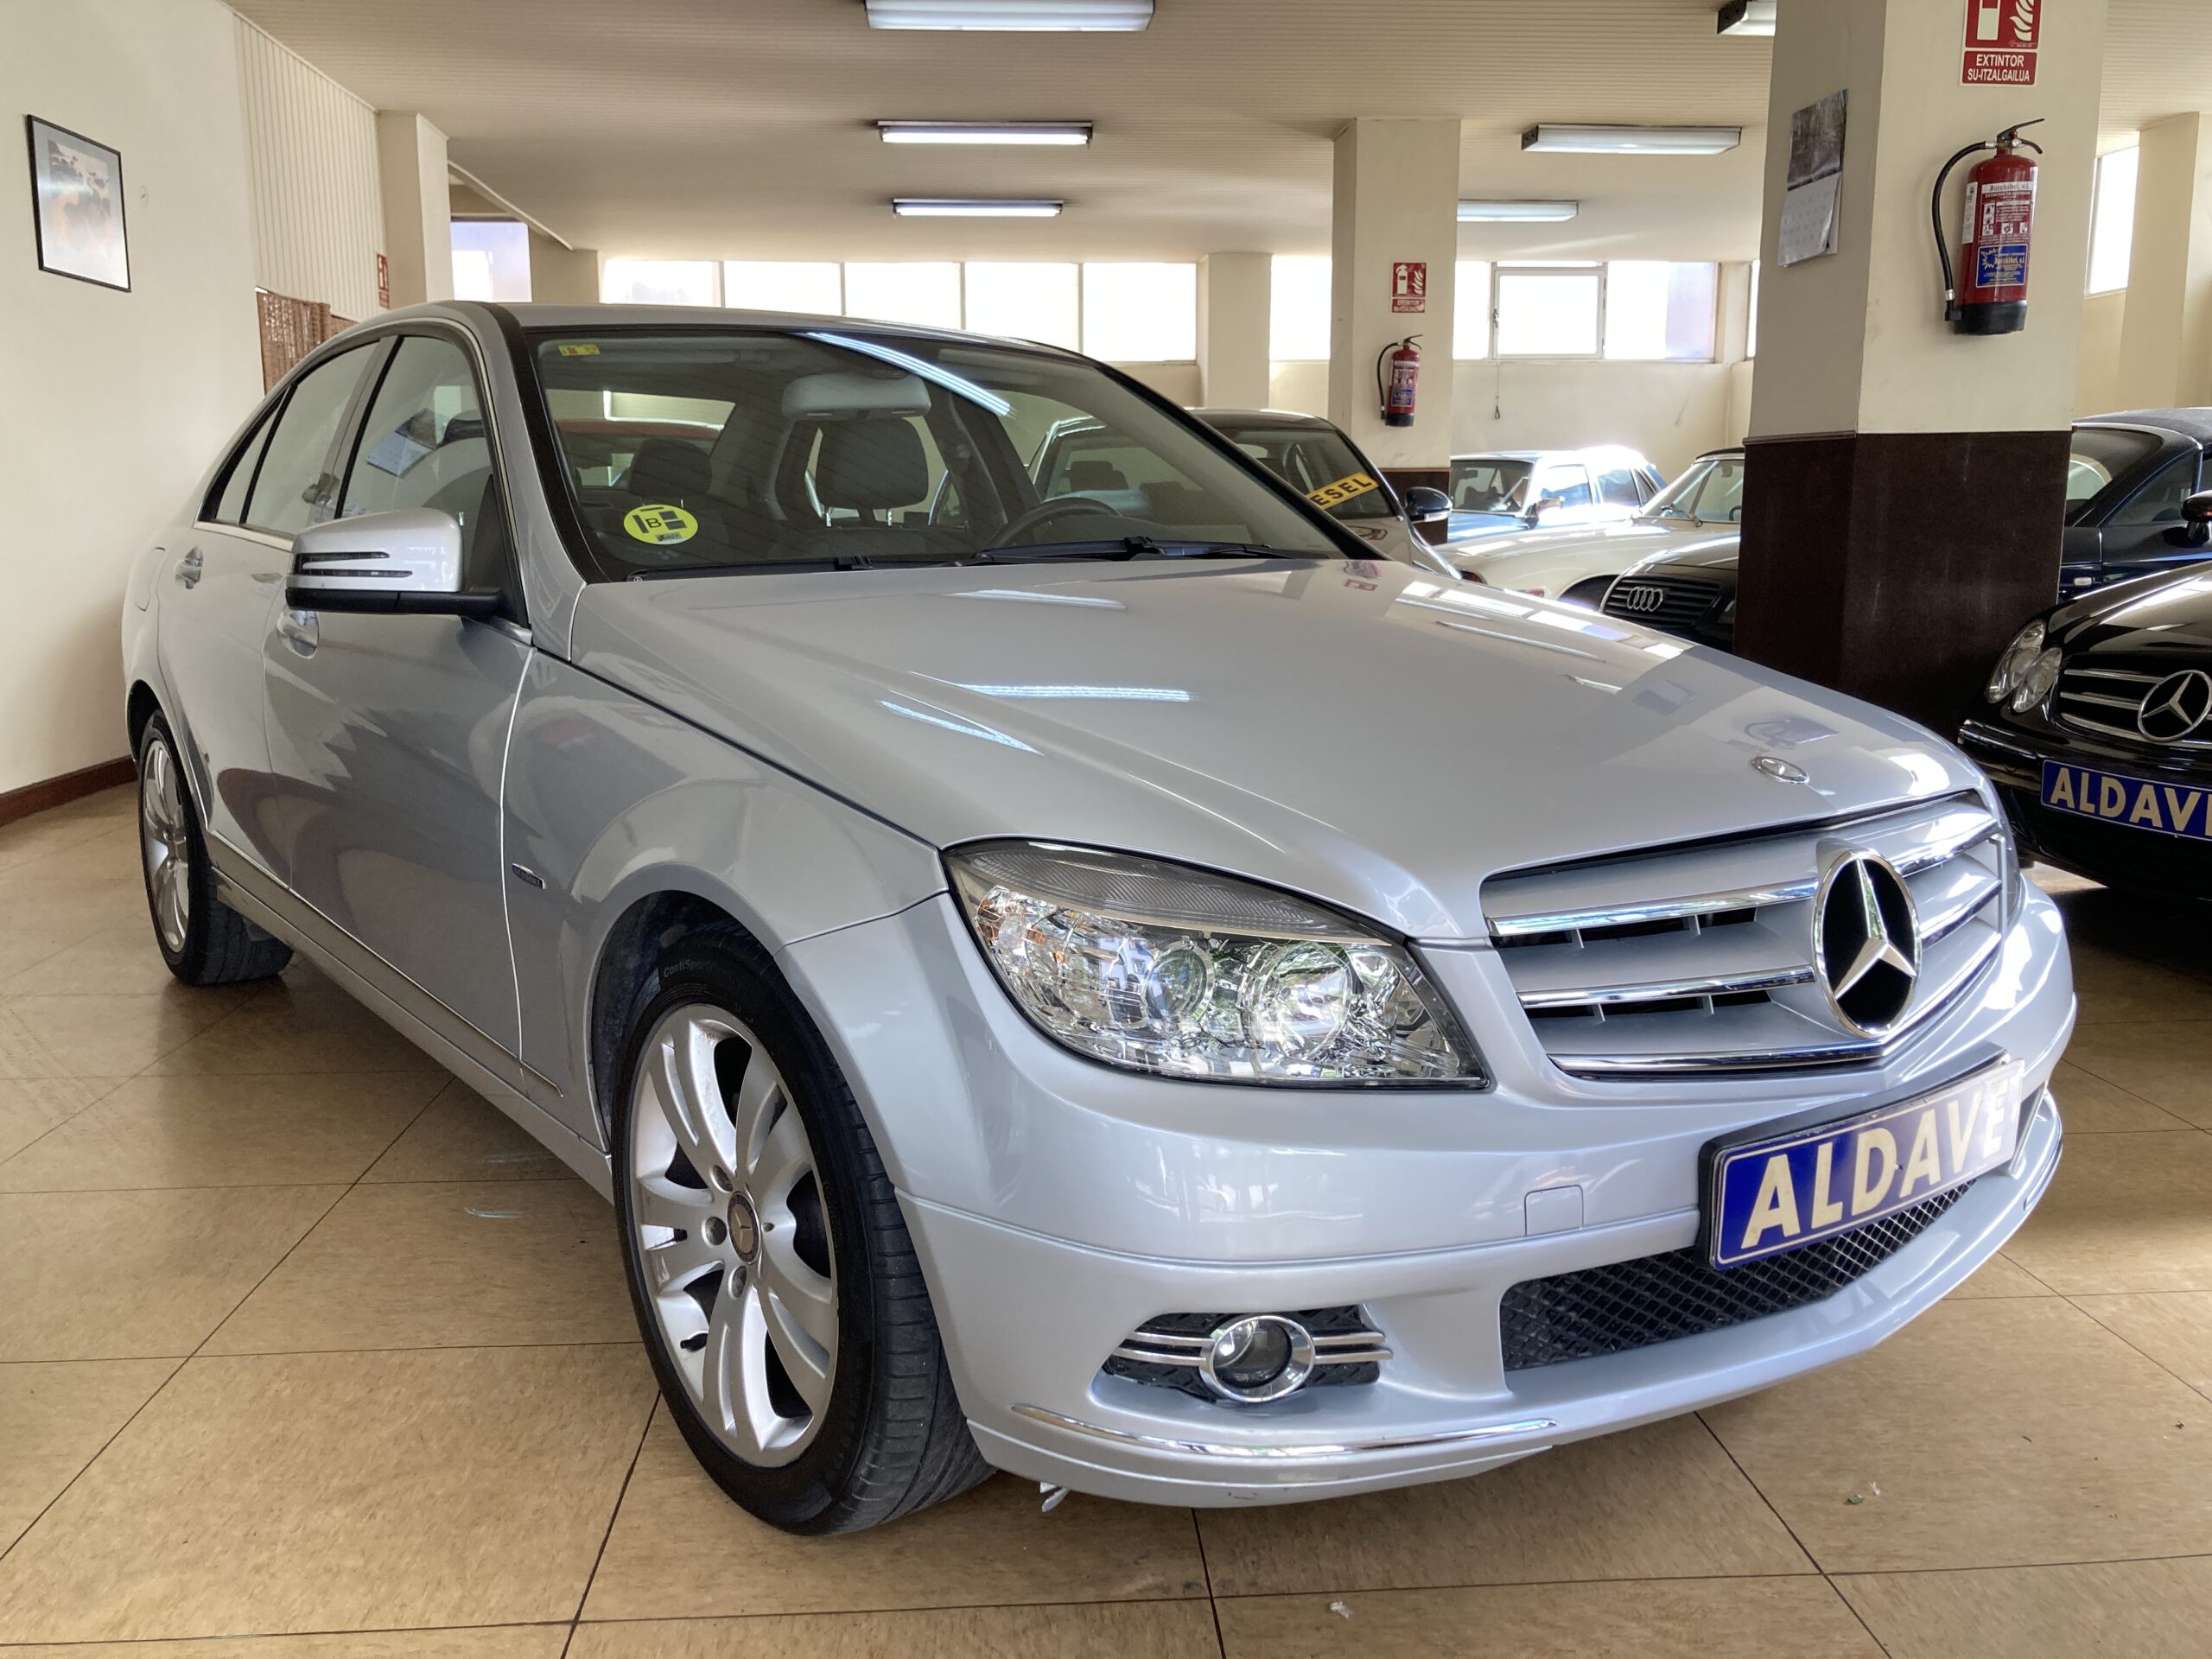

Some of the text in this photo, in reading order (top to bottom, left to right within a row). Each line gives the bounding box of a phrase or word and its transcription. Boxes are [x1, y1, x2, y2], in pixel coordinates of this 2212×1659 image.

[1975, 54, 2024, 67] EXTINTOR
[1967, 68, 2030, 82] SU-ITZALGAILUA
[1309, 478, 1373, 506] ESEL
[645, 518, 662, 529] B
[1740, 1077, 2010, 1250] ALDAVE
